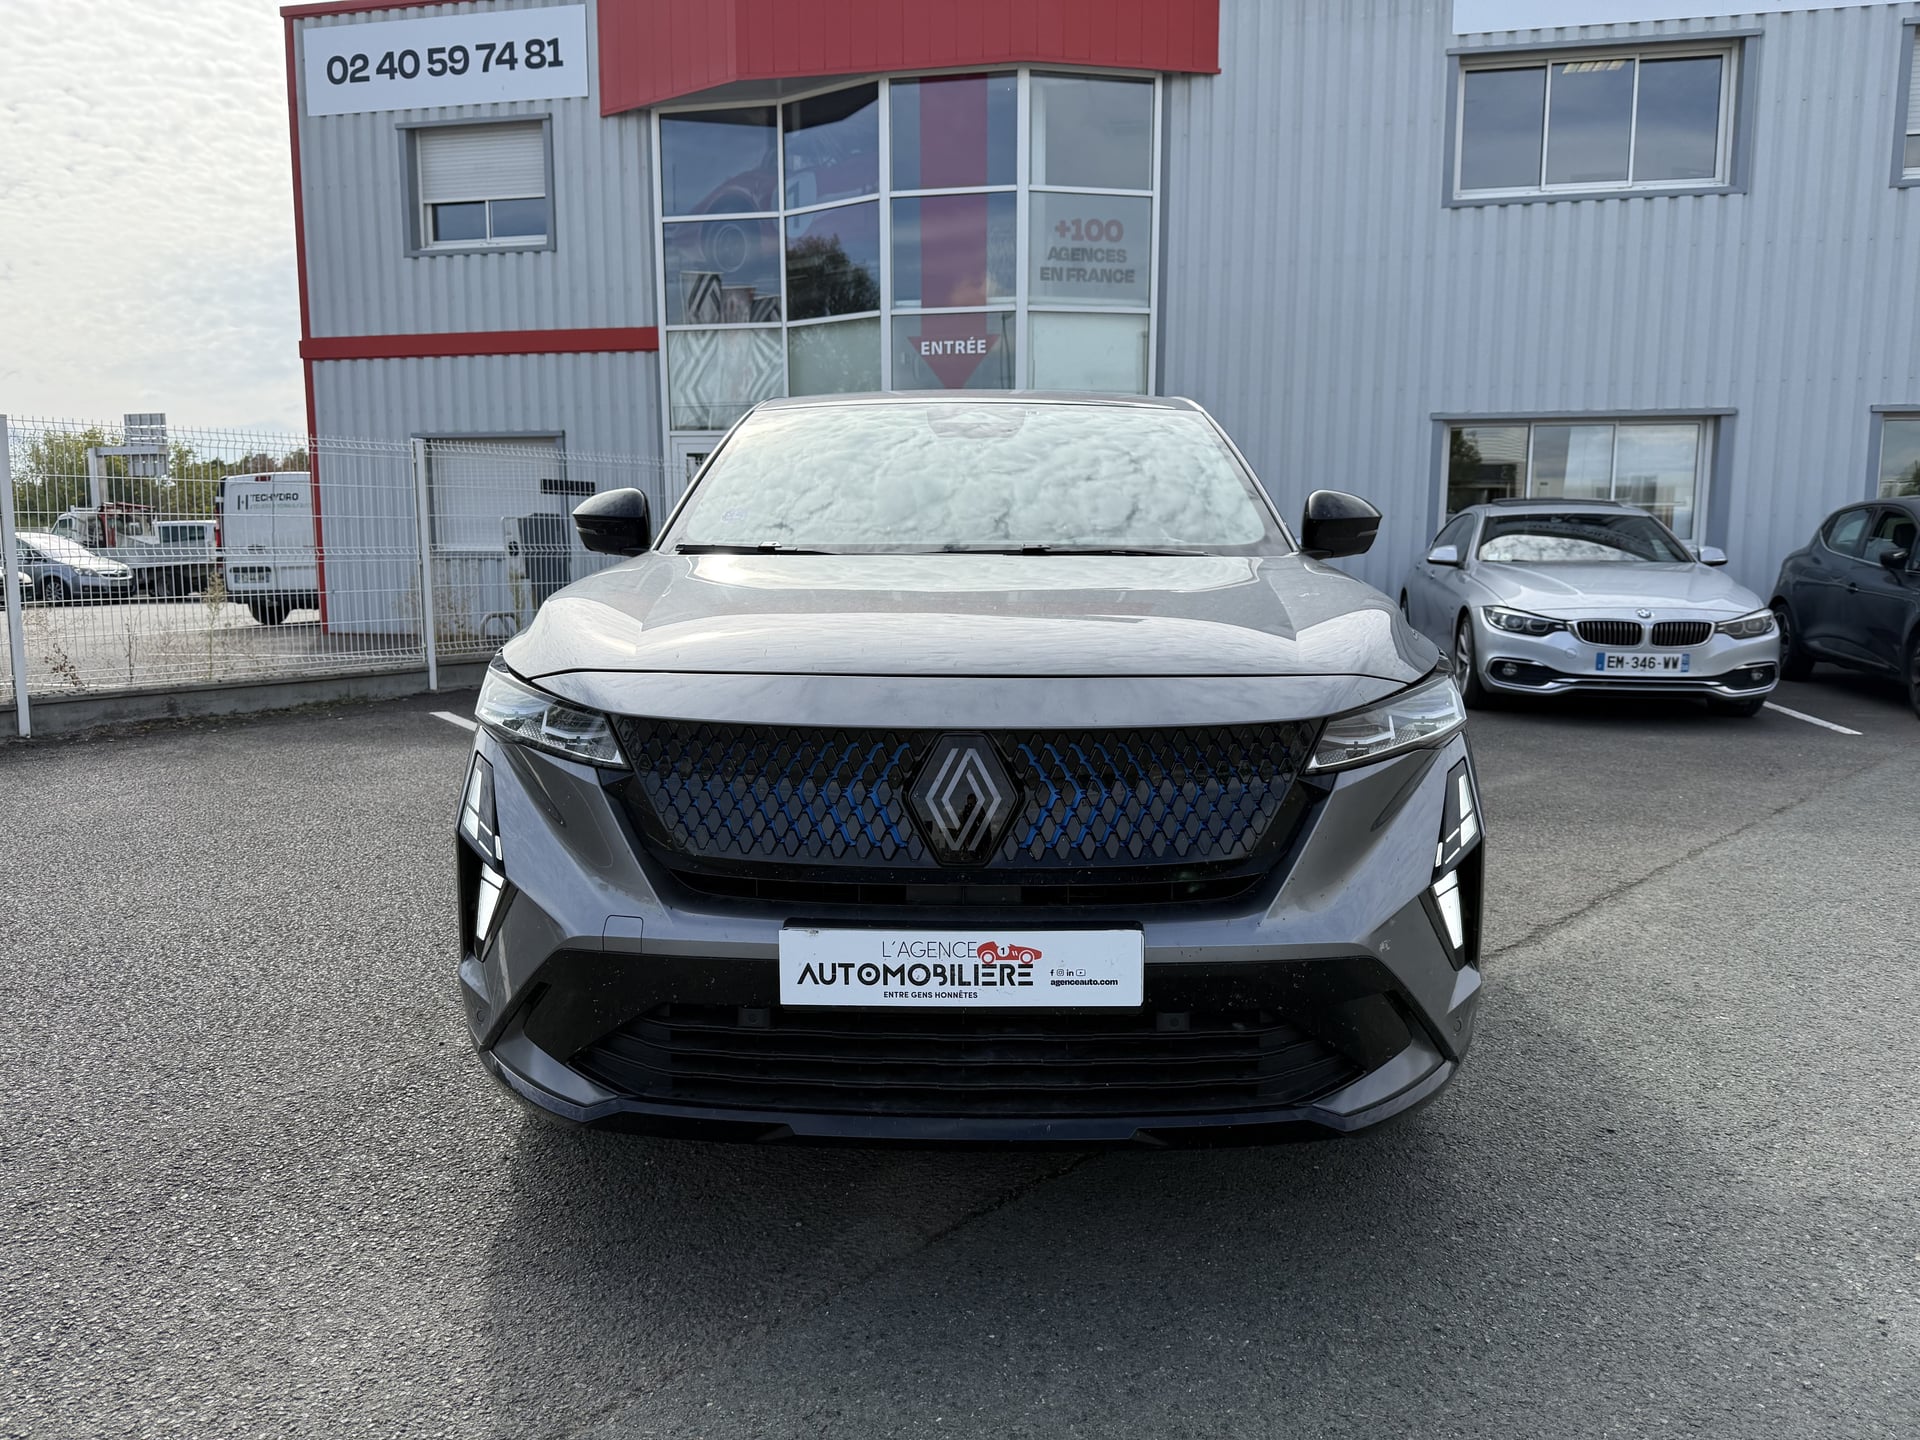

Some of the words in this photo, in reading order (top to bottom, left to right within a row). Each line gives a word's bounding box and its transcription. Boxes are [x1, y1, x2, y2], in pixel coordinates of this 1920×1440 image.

[326, 53, 370, 85] 02
[375, 49, 420, 80] 40
[427, 45, 470, 77] 59
[475, 41, 518, 73] 74
[524, 37, 564, 69] 81
[1054, 218, 1124, 242] +100
[1047, 246, 1128, 263] AGENCES
[1040, 266, 1063, 282] EN
[1066, 267, 1135, 283] FRANCE
[920, 336, 987, 355] ENTRÉE
[882, 940, 978, 959] L'AGENCE
[1050, 978, 1118, 987] agenceauto.com
[883, 991, 909, 999] ENTRE
[911, 991, 933, 999] GENS
[934, 989, 978, 999] HONNÊTES
